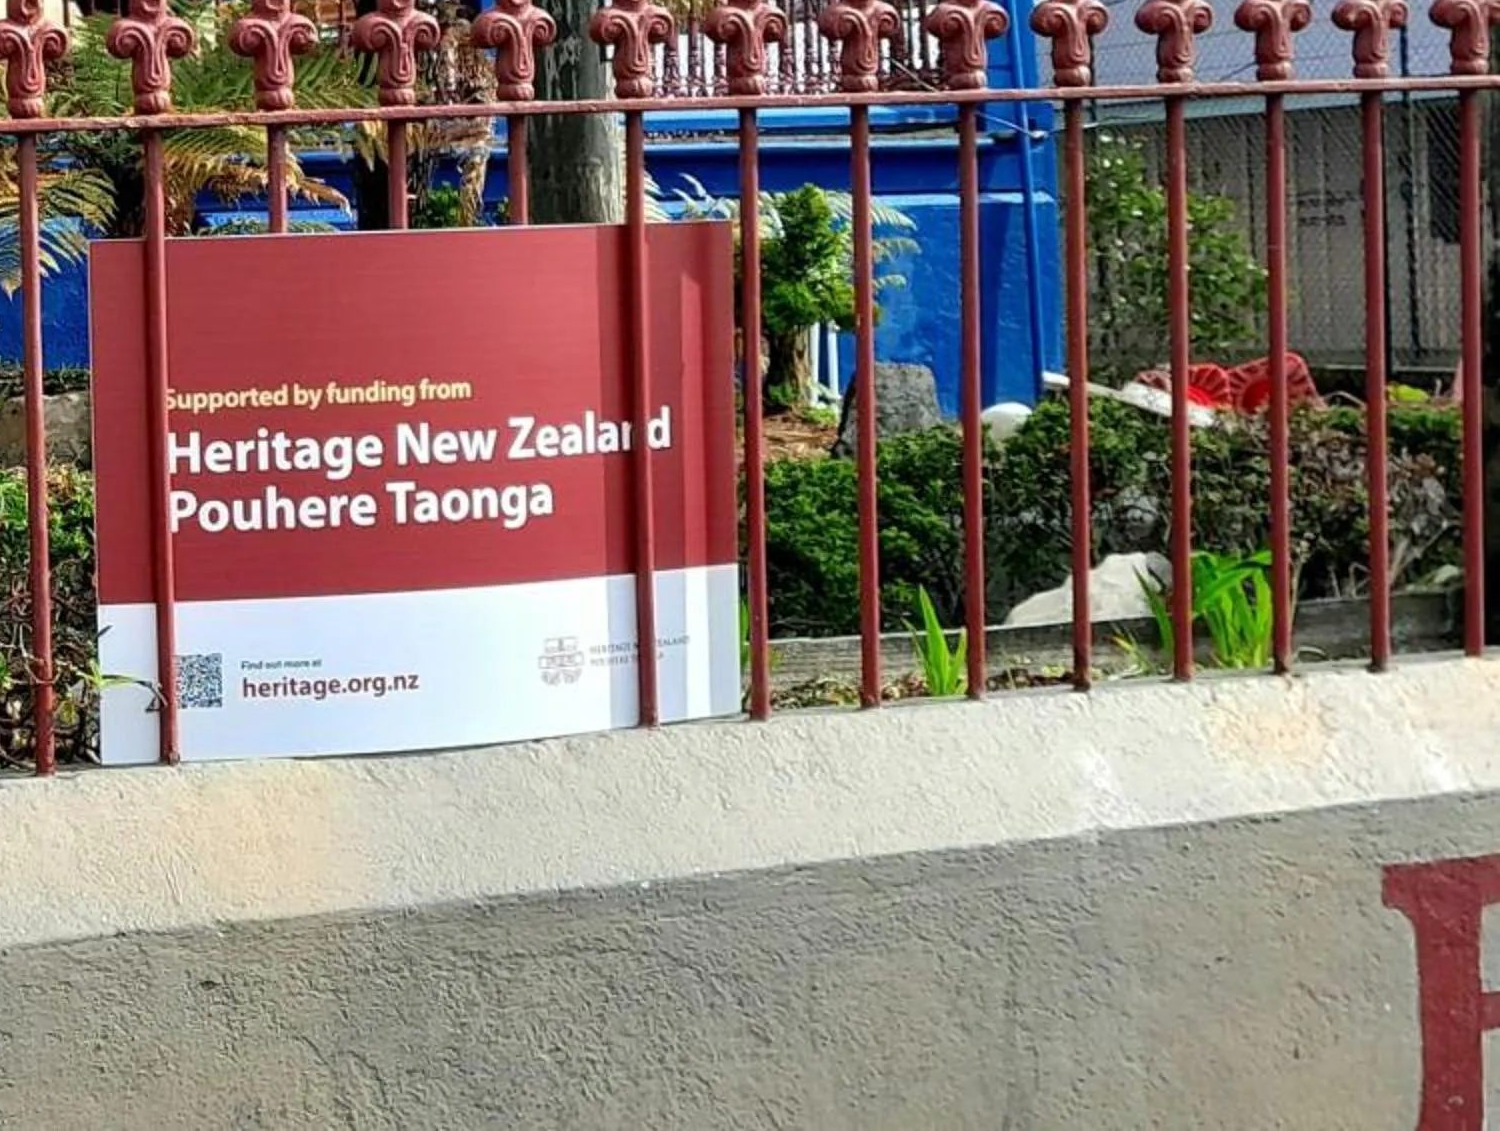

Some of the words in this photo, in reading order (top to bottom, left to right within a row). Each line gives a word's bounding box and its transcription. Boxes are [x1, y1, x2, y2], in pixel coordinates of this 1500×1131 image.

[166, 384, 288, 414] Supported
[293, 383, 322, 410] by
[326, 380, 416, 407] funding
[418, 378, 472, 401] from
[167, 426, 384, 480] Heritage
[396, 422, 497, 466] New
[168, 485, 378, 534] Pouhere
[385, 481, 553, 530] Taonga
[241, 660, 263, 670] Find
[242, 673, 420, 701] heritage.org.nz
